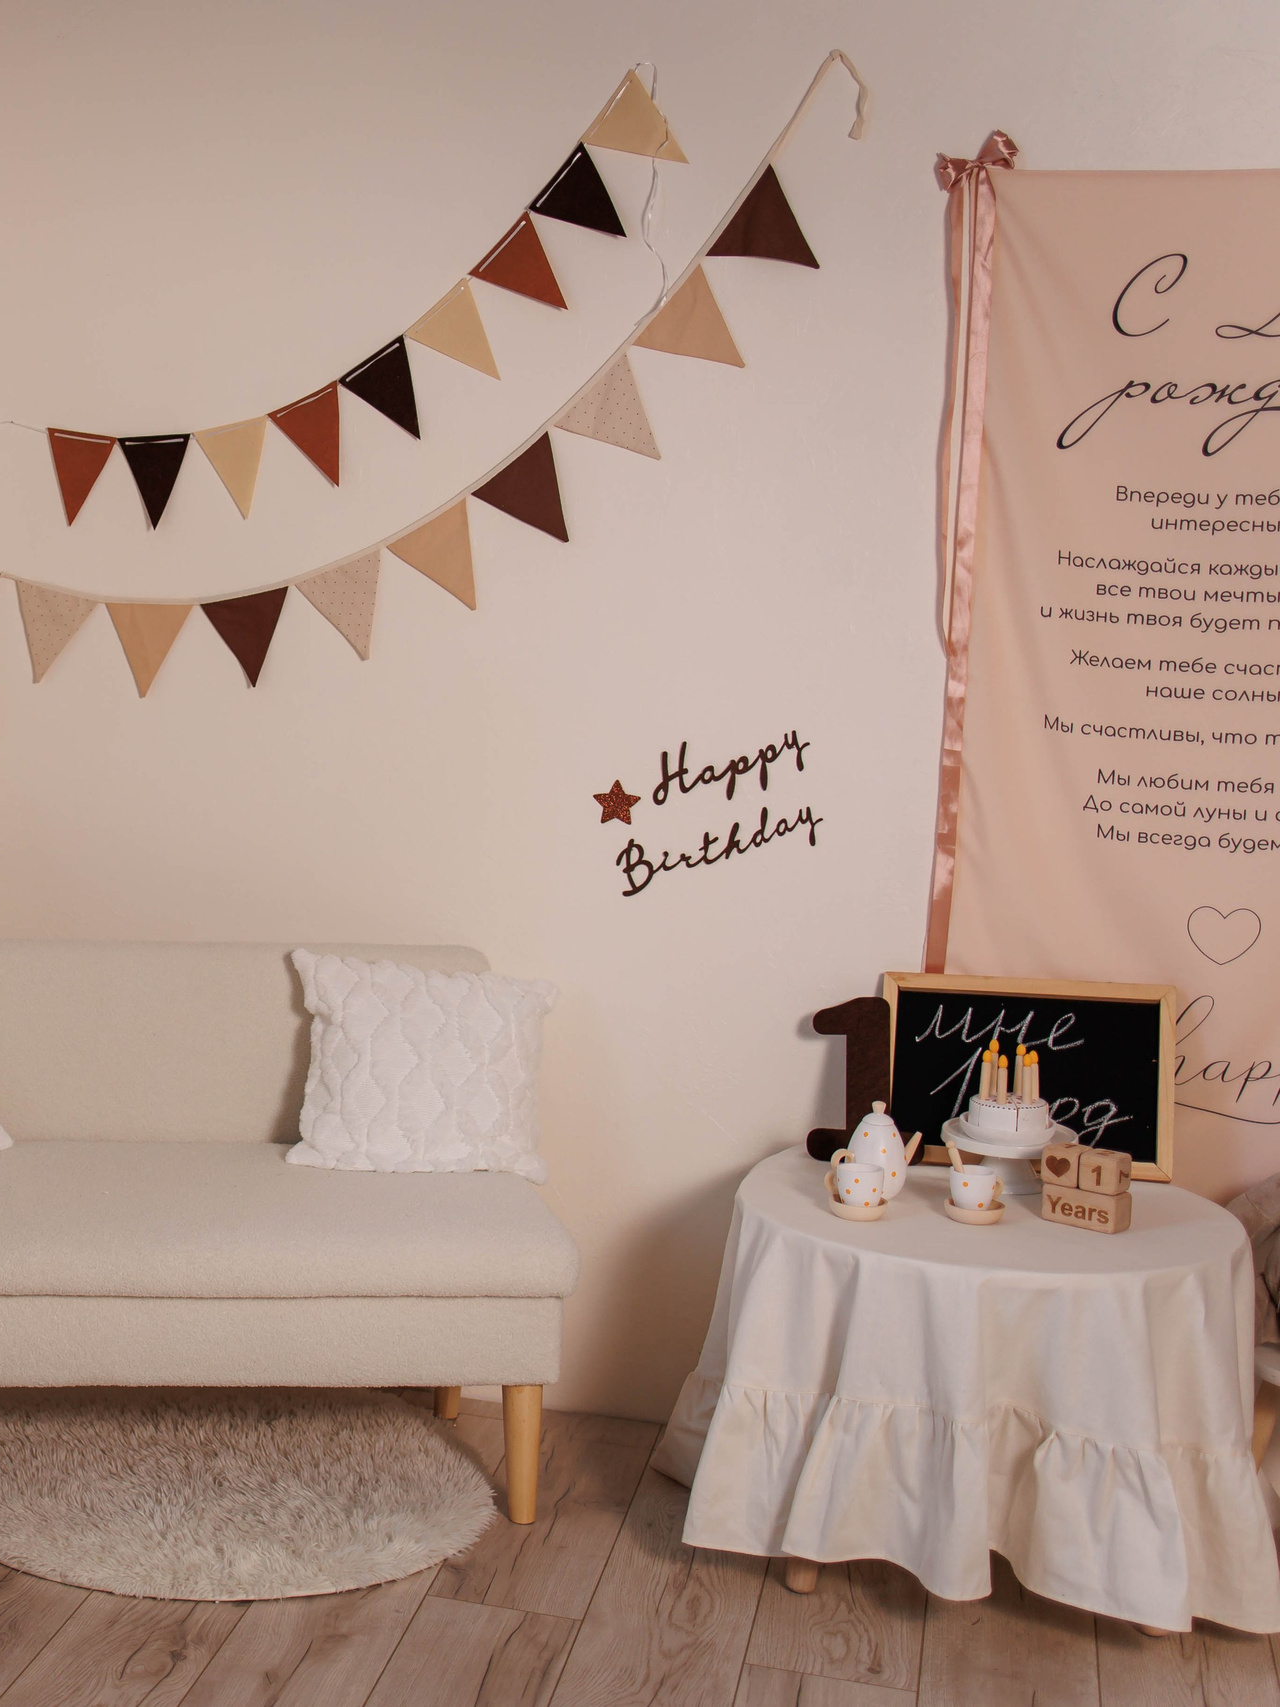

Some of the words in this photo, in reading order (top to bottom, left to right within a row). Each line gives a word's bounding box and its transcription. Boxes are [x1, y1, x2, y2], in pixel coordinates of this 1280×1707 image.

[1112, 253, 1188, 337] С
[1116, 486, 1209, 508] Впереди
[1215, 494, 1228, 509] у
[1235, 489, 1280, 505] теб
[1151, 518, 1280, 536] интересны
[1058, 550, 1200, 575] Наслаждайся
[1209, 564, 1278, 580] кажды
[1096, 584, 1131, 597] все
[1139, 586, 1195, 601] твои
[1204, 591, 1280, 603] мечты
[1041, 606, 1052, 617] и
[1059, 608, 1119, 623] жизнь
[1127, 613, 1182, 627] твоя
[1190, 613, 1260, 633] будет
[1070, 649, 1151, 670] Желаем
[1159, 657, 1217, 673] тебе
[1224, 663, 1280, 675] счас
[1146, 686, 1205, 699] наше
[1212, 689, 1280, 702] солны
[1044, 714, 1073, 733] Мы
[1081, 724, 1204, 745] счастливы,
[1212, 732, 1257, 745] что
[652, 730, 811, 806] Happy
[1098, 768, 1130, 786] Мы
[1137, 773, 1209, 791] любим
[1217, 777, 1274, 794] тебя
[1083, 795, 1112, 813] До
[1120, 801, 1186, 817] самой
[1193, 807, 1246, 823] луны
[1255, 810, 1267, 821] и
[616, 806, 823, 897] Birthday
[1097, 824, 1130, 842] Мы
[1138, 832, 1210, 850] всегда
[1218, 833, 1280, 854] будем
[1048, 1097, 1133, 1148] од
[1091, 1164, 1103, 1187] 1
[1046, 1193, 1110, 1225] Years
